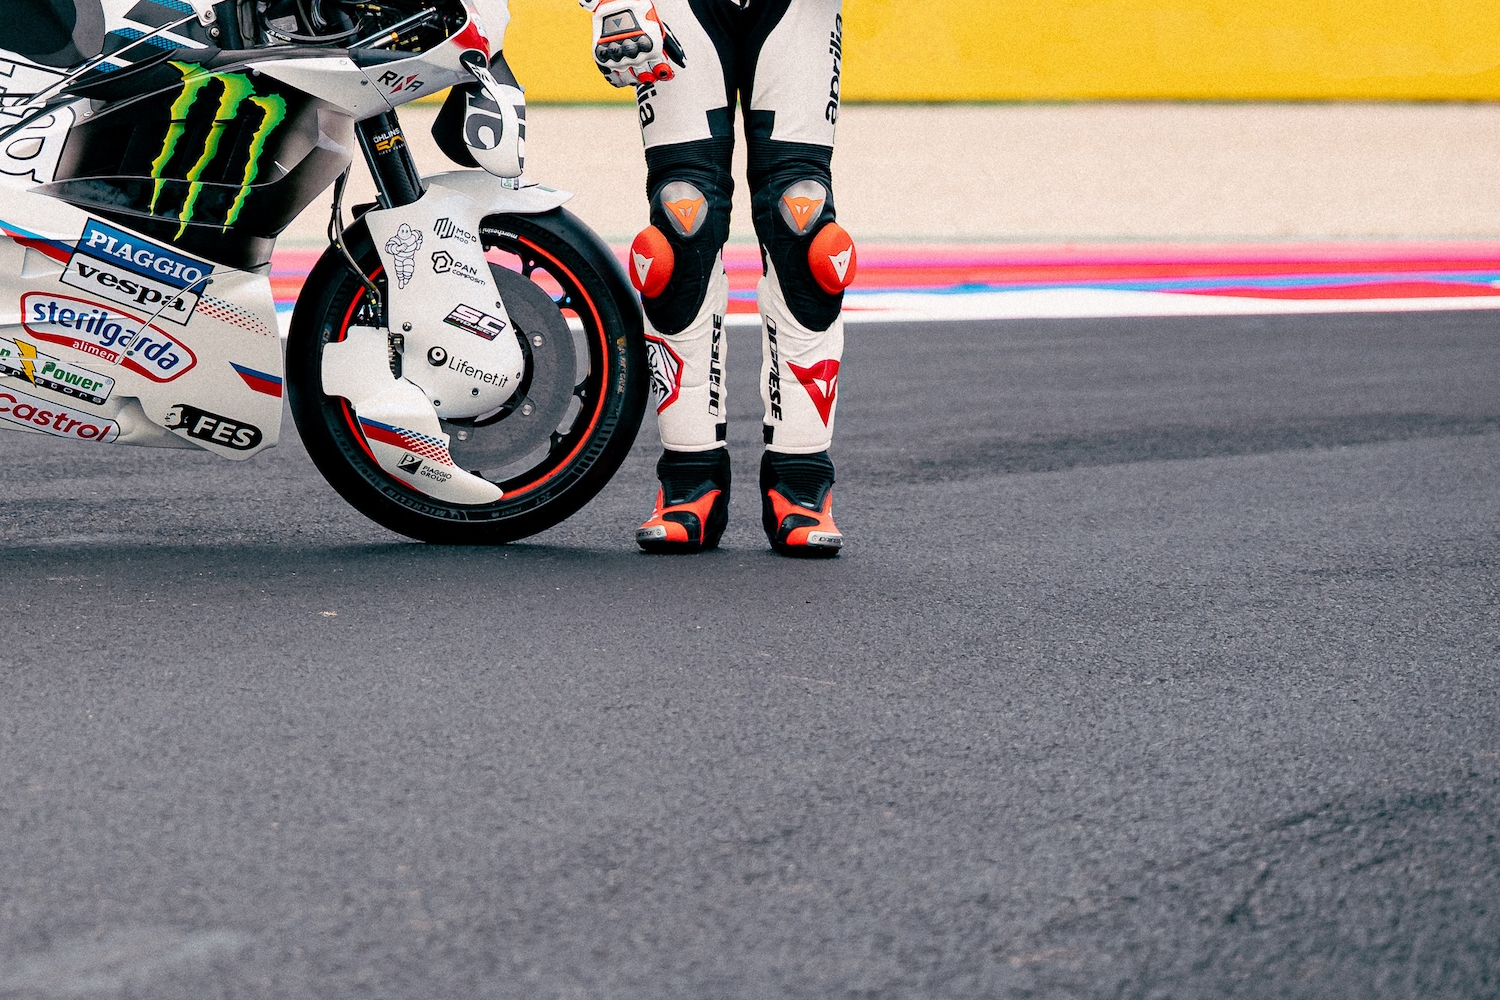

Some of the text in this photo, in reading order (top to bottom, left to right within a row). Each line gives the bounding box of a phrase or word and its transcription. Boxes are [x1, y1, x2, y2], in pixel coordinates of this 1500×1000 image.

[482, 226, 518, 240] marchesini
[86, 229, 203, 285] PIAGGIO
[454, 261, 478, 276] PAN
[76, 261, 187, 313] vespa
[451, 269, 486, 286] COMPOSITI
[450, 305, 505, 334] SC
[33, 301, 180, 371] sterilgarda
[41, 361, 104, 393] Power
[448, 356, 509, 388] Lifenet.it
[707, 313, 723, 417] DAINESE
[765, 314, 783, 421] DAINESE
[194, 413, 256, 448] FES
[420, 470, 447, 484] GROUP
[422, 465, 452, 480] PIAGGIO
